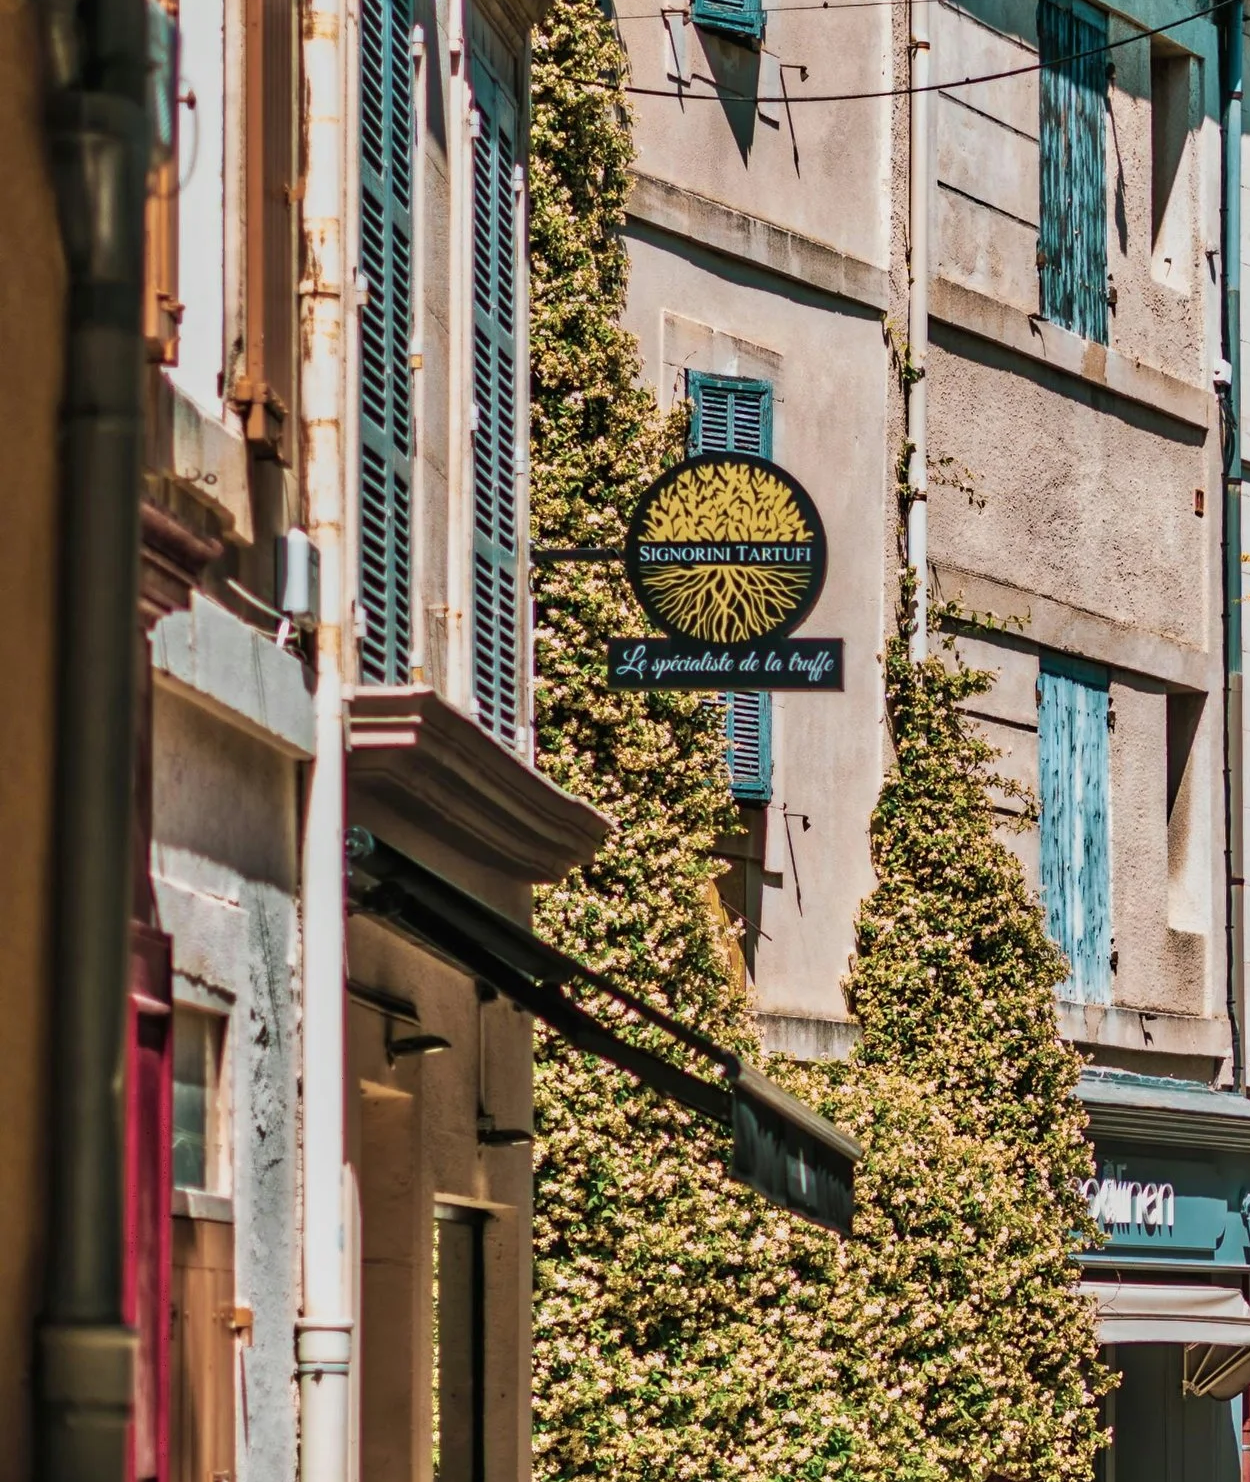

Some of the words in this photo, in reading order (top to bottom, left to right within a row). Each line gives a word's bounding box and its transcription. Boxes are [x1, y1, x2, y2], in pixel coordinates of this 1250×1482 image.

[639, 545, 731, 562] SIGNORINI
[736, 545, 812, 562] TARTUFI
[616, 645, 647, 679] Le
[651, 650, 735, 679] spécialiste
[739, 651, 760, 672] de
[764, 651, 783, 672] la
[788, 651, 834, 681] truffe
